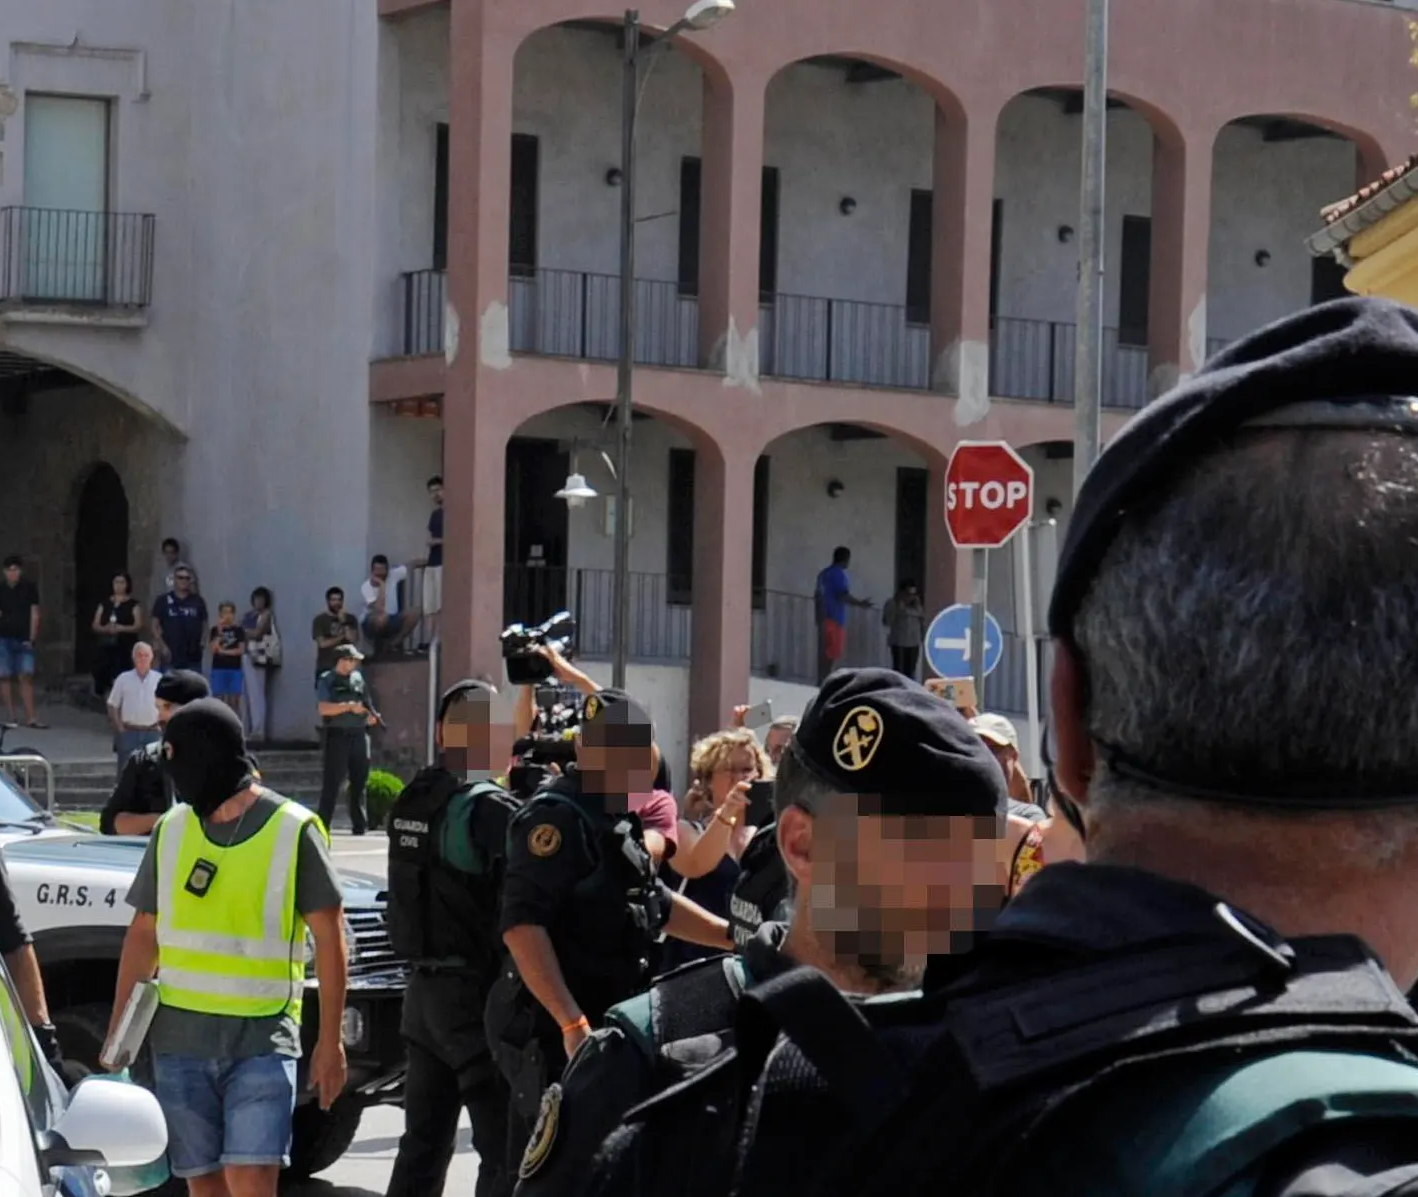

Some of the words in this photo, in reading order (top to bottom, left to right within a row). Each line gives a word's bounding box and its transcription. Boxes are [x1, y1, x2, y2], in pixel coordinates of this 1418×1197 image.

[947, 480, 1027, 511] STOP
[393, 818, 429, 833] GUARDIA
[36, 883, 92, 907] G.R.S.
[104, 888, 116, 908] 4
